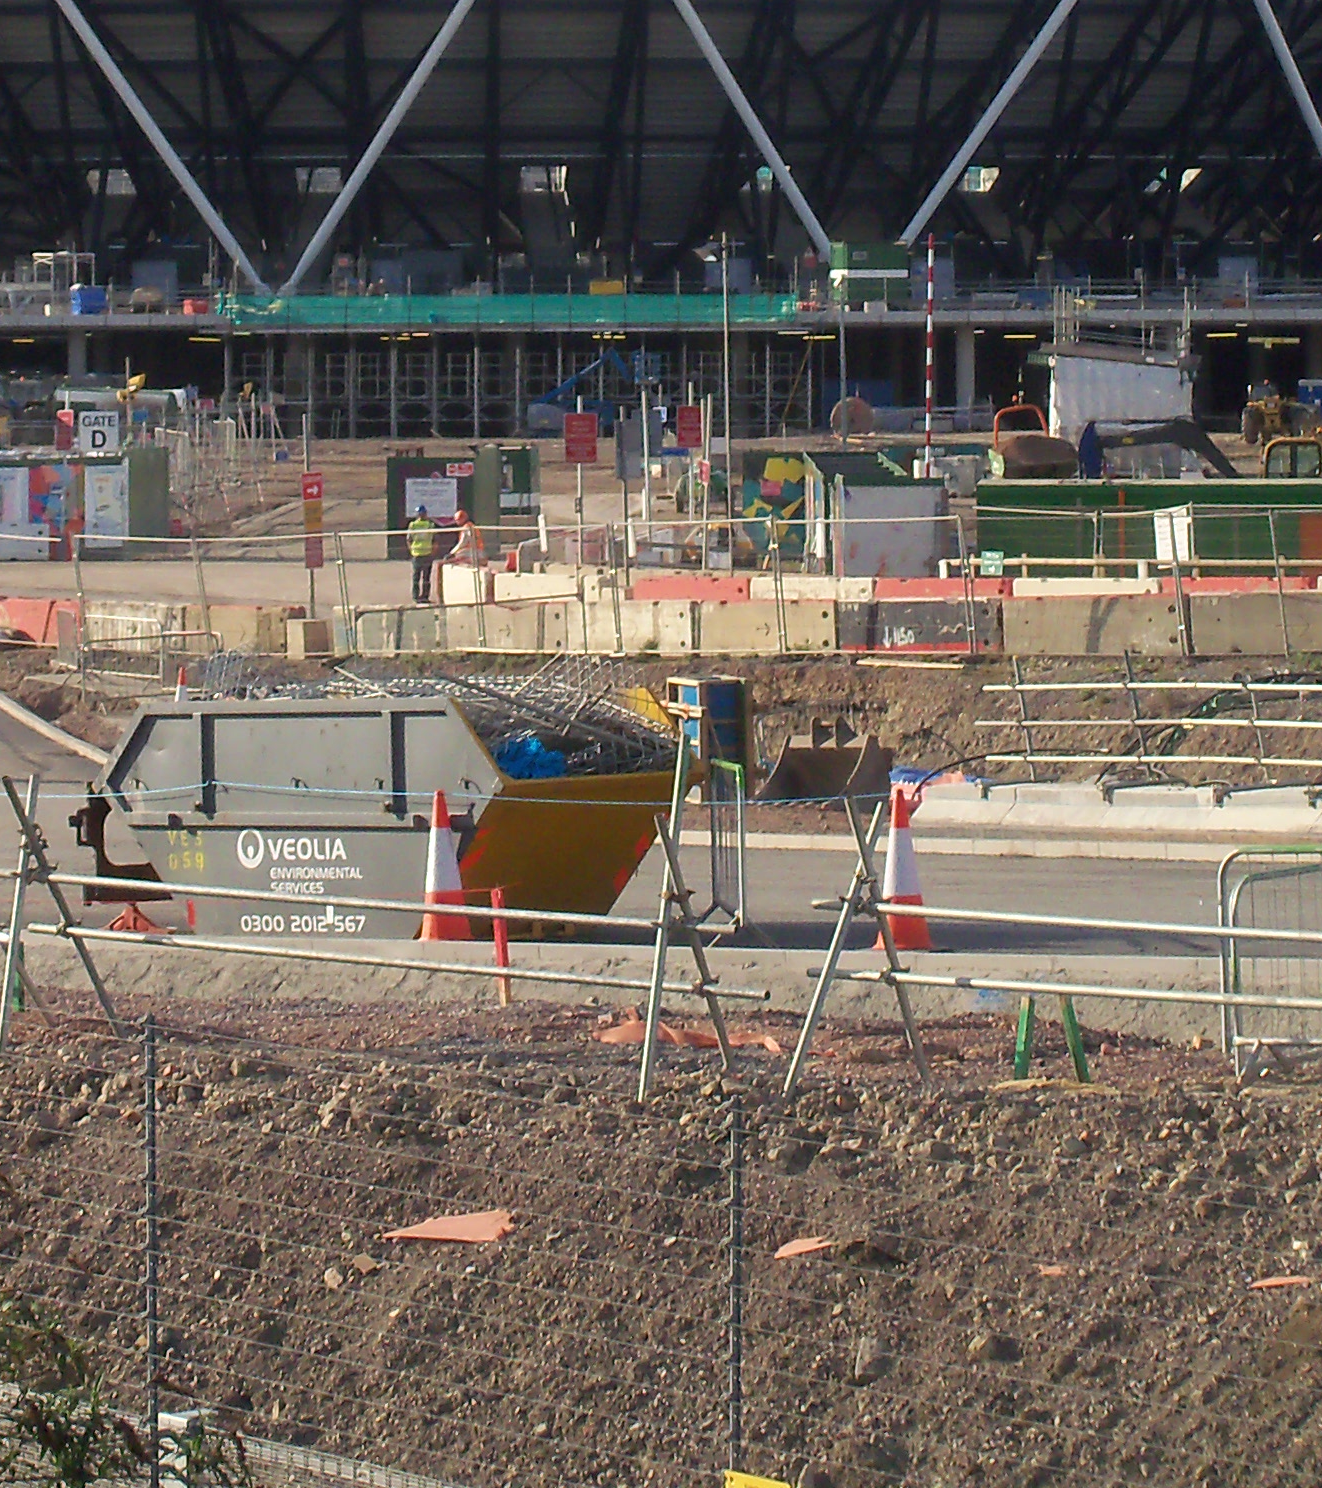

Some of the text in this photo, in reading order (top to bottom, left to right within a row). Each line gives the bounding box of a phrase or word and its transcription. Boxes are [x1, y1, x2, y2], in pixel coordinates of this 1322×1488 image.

[82, 416, 116, 428] GATE
[91, 429, 107, 448] D
[267, 837, 348, 861] VEOLIA
[269, 866, 364, 881] ENVIRONMENTAL
[270, 881, 325, 894] SERVICES
[240, 914, 366, 933] 0300 2012 567
